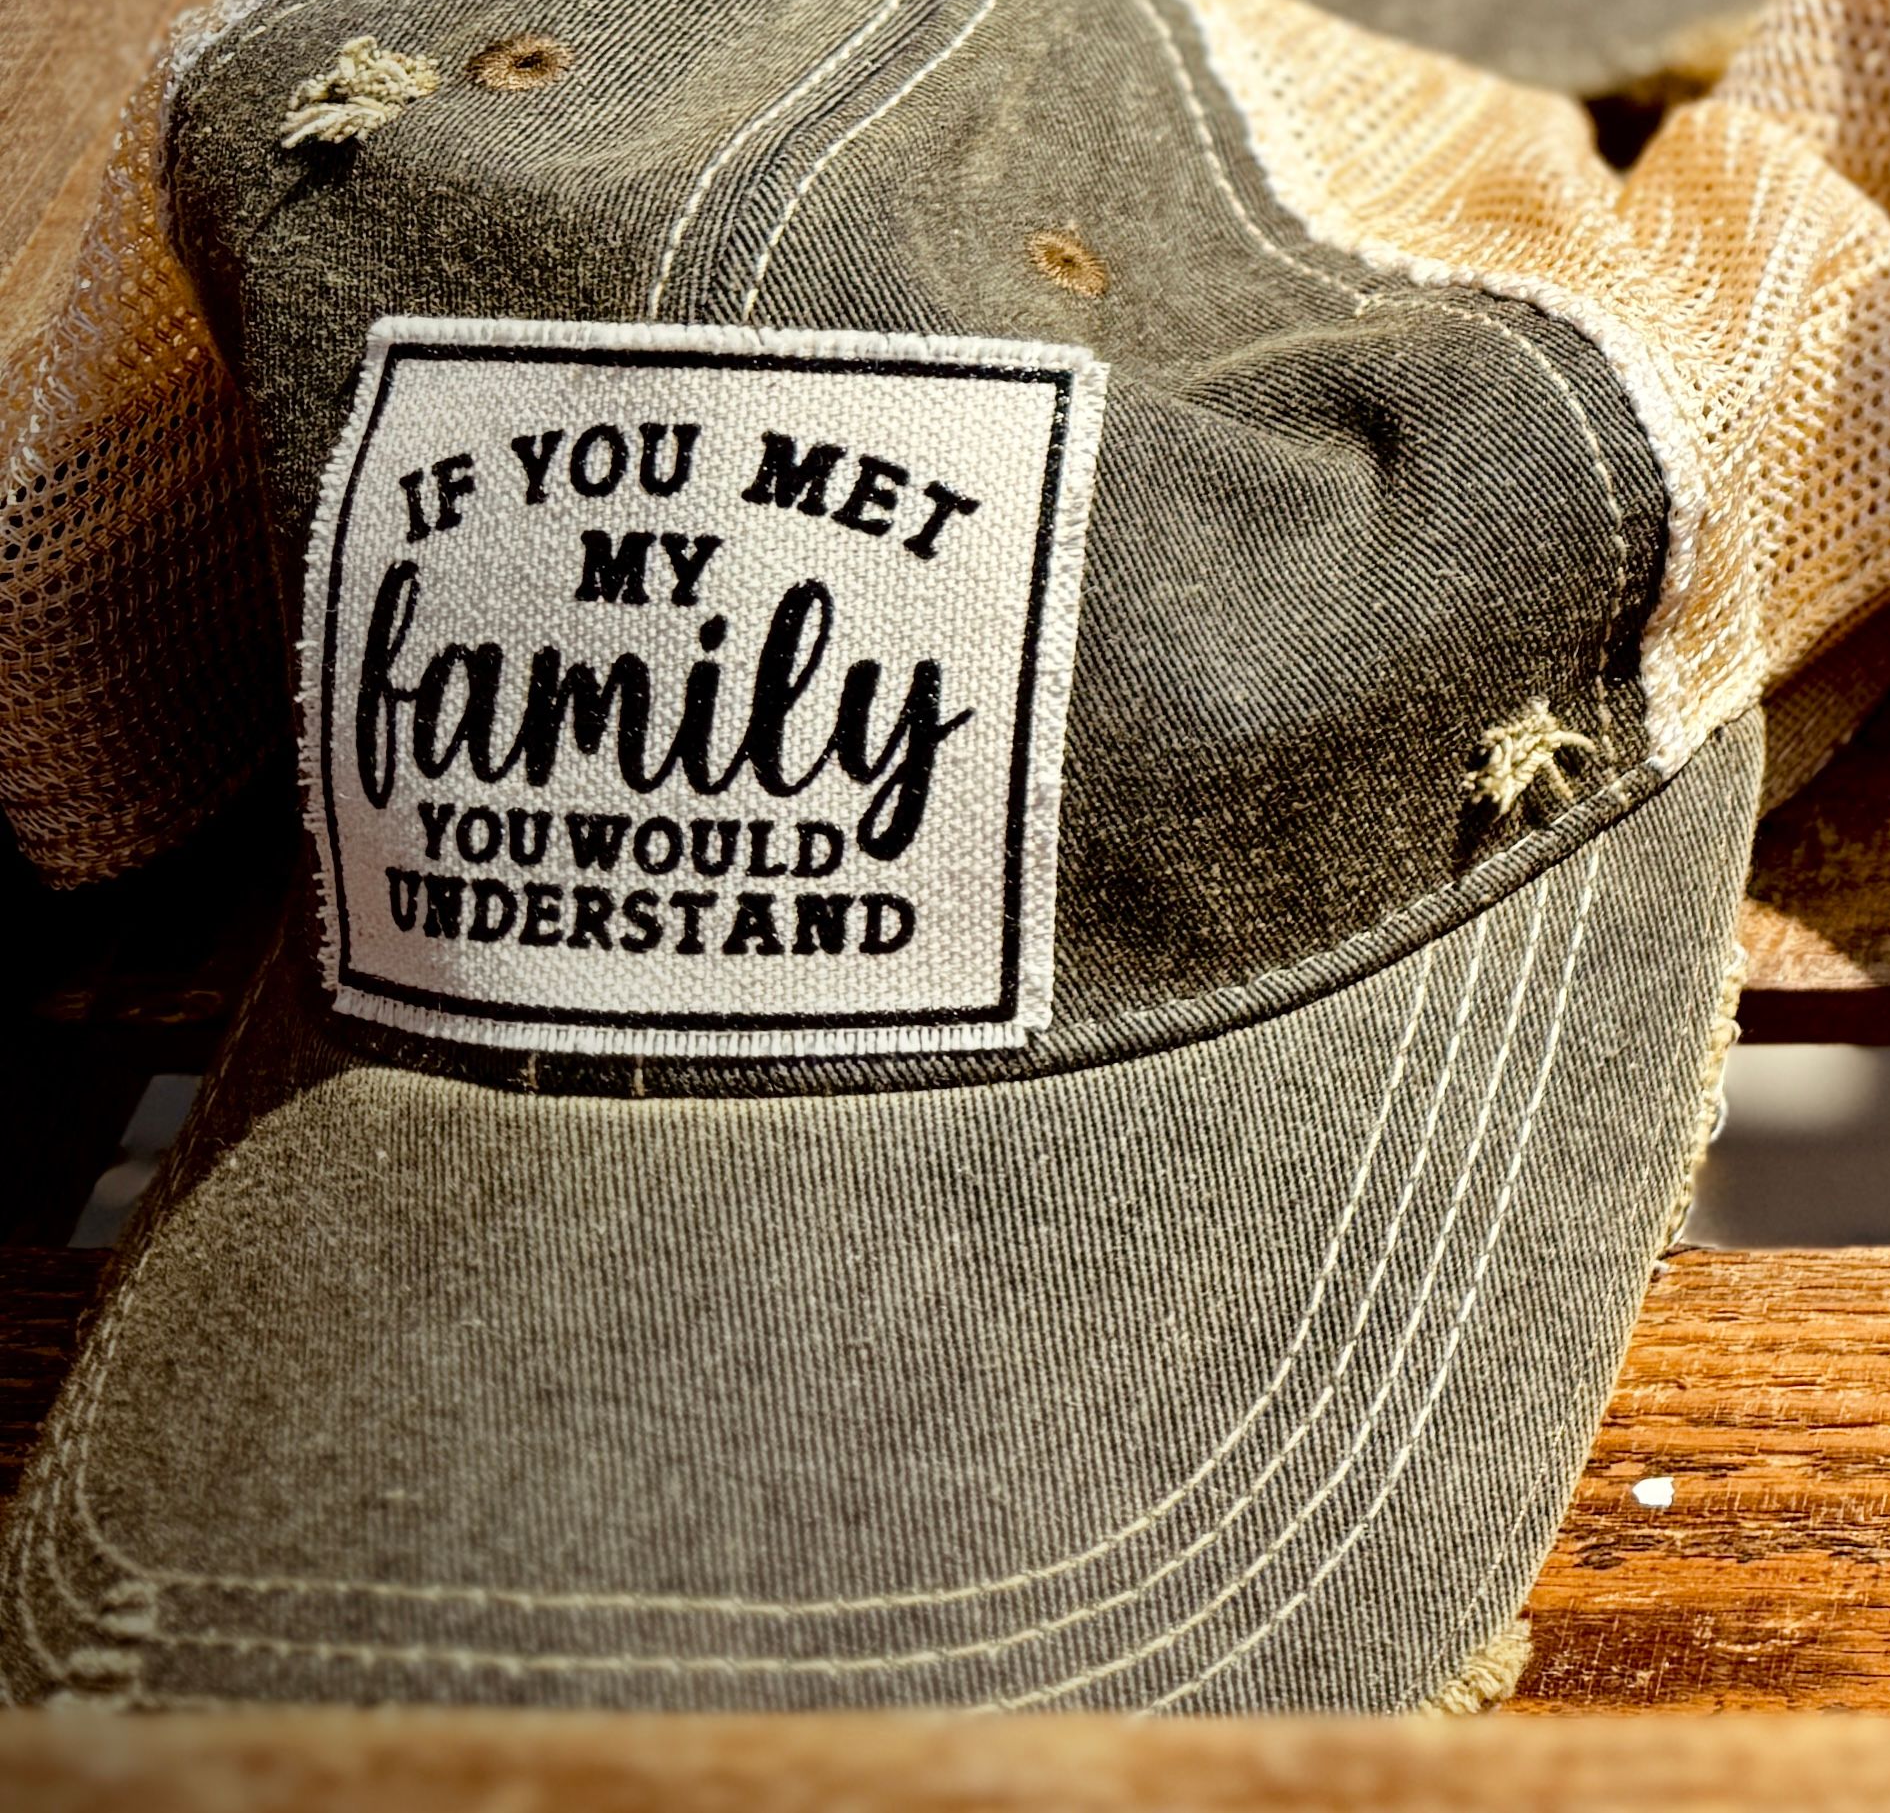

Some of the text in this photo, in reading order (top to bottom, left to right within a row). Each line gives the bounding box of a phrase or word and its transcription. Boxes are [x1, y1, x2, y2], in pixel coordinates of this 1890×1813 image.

[400, 421, 980, 560] IF YOU MET
[574, 529, 724, 606] MY
[355, 559, 976, 862] family
[417, 801, 845, 878] YOU WOULD
[386, 867, 916, 956] UNDERSTAND
